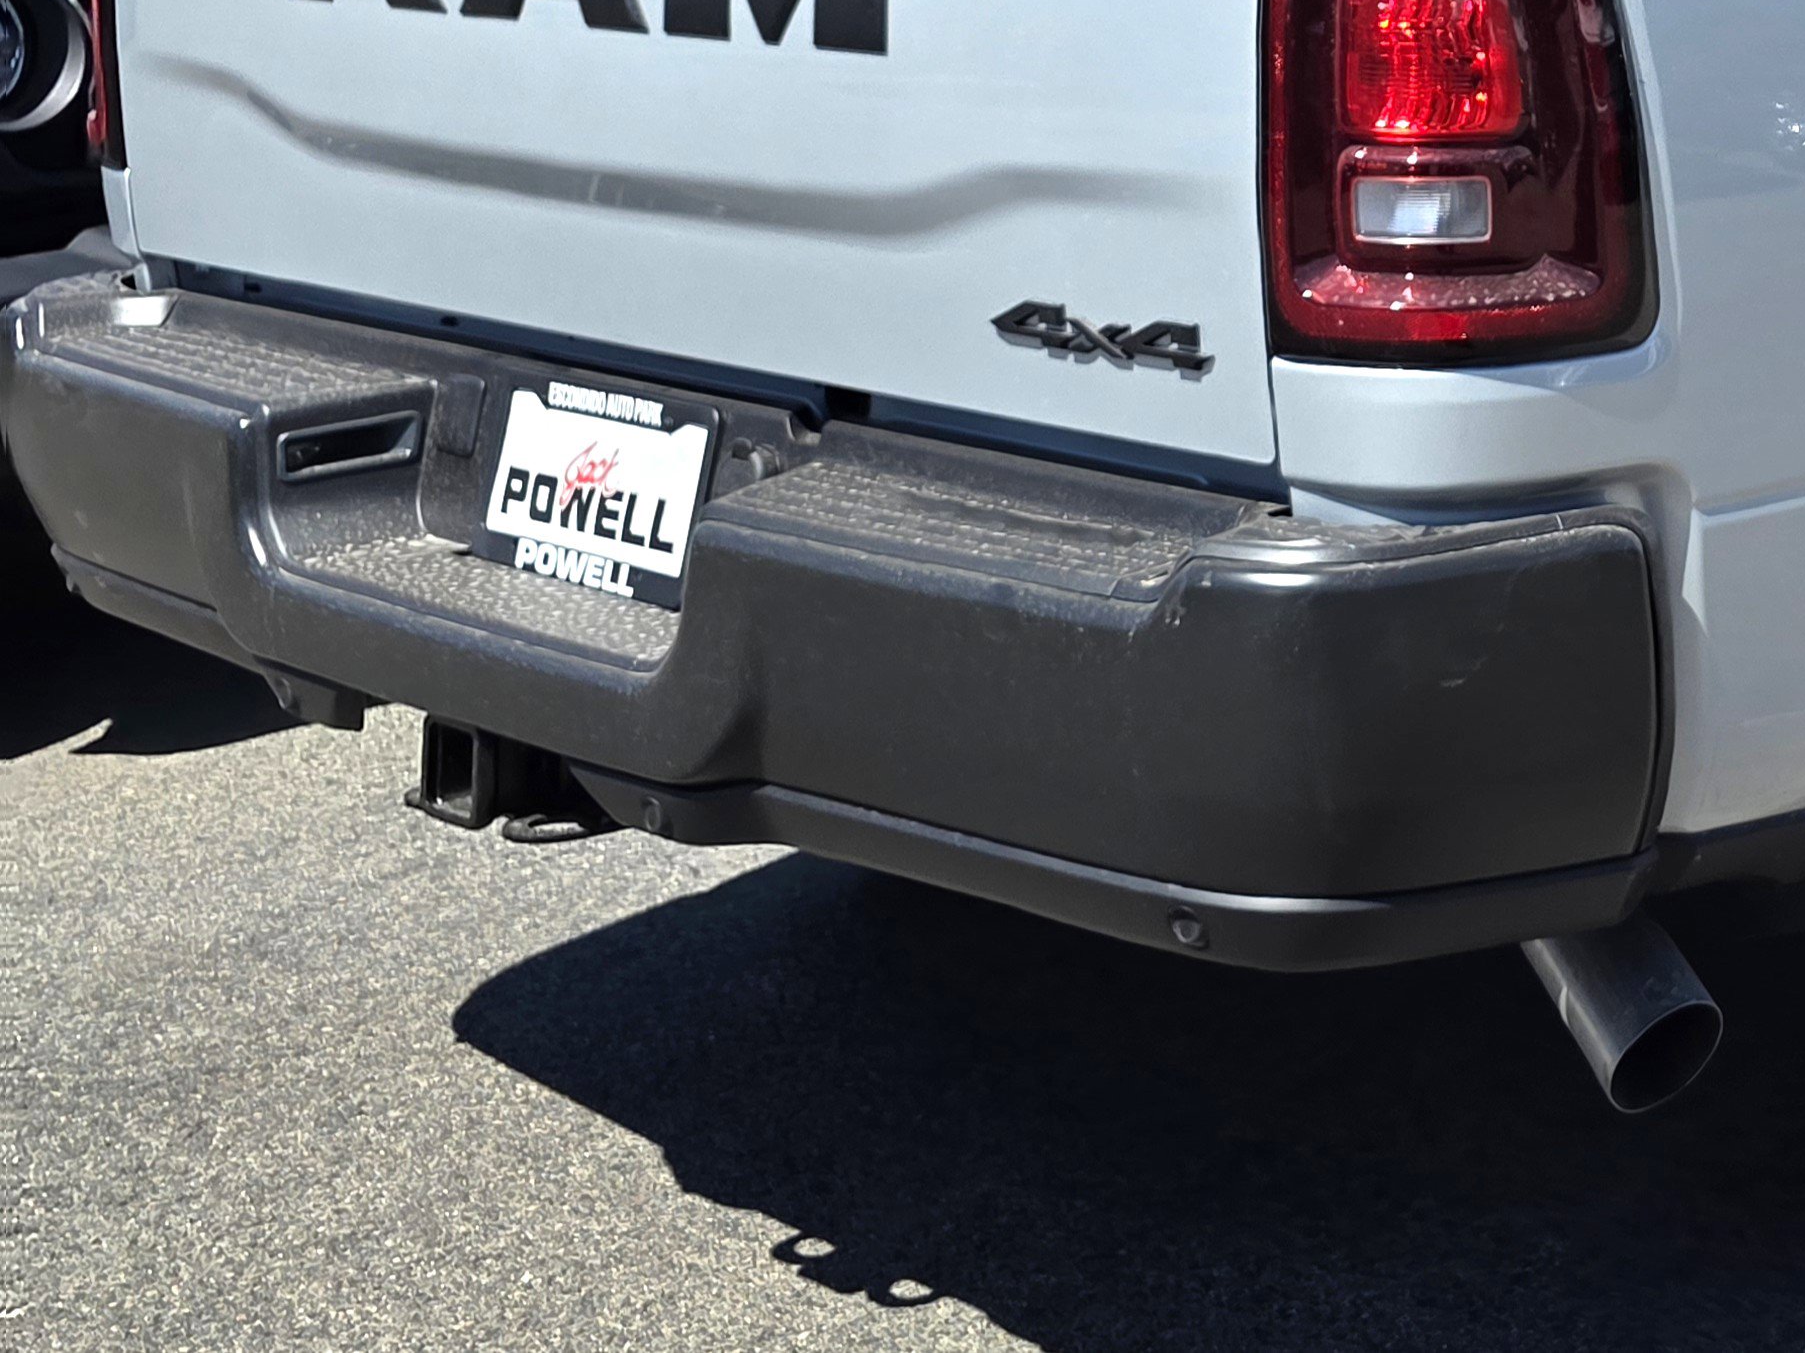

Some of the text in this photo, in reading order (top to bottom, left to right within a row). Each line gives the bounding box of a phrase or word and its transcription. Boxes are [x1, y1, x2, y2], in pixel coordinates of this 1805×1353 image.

[606, 392, 635, 422] AUTO
[633, 397, 664, 428] PARK
[559, 441, 619, 507] Jack
[501, 465, 673, 554] POWELL
[514, 537, 634, 598] POWELL
